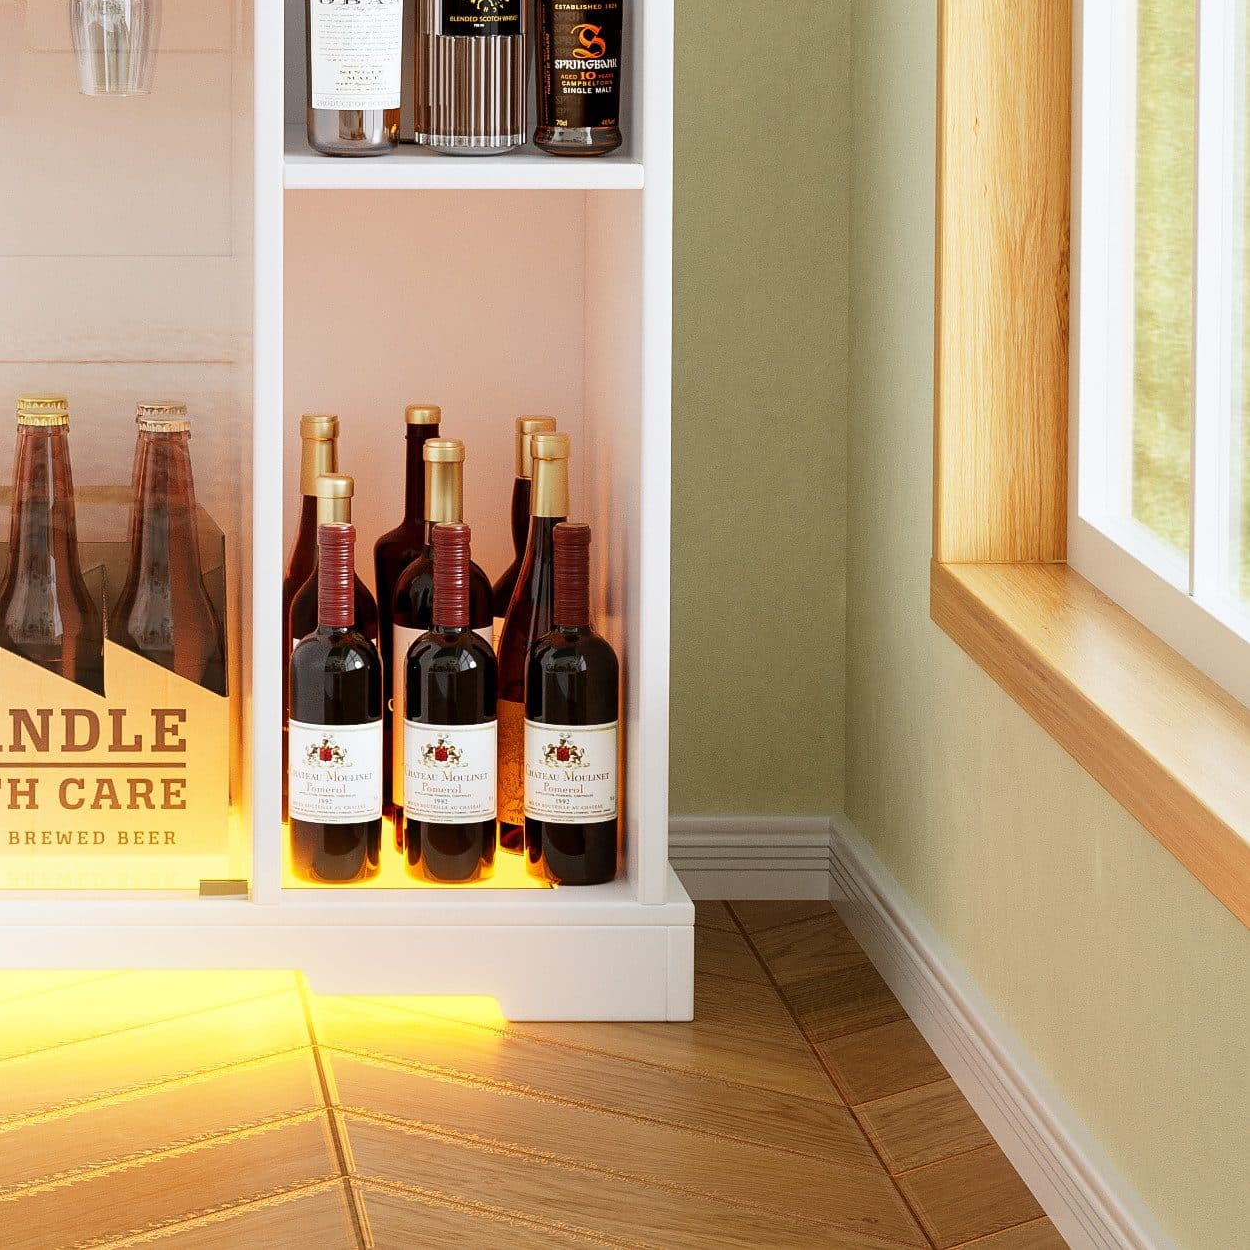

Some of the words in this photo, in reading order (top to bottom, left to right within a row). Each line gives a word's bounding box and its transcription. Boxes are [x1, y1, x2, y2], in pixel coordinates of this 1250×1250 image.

[554, 3, 602, 11] ESTABLISHED
[554, 58, 617, 70] SPRINGBANK
[580, 71, 596, 80] 10
[307, 782, 346, 793] Pomerol
[422, 782, 462, 793] Pomerol
[543, 782, 583, 793] Pomerol
[58, 778, 187, 809] CARE
[8, 831, 105, 845] BREWED
[117, 831, 176, 845] BEER
